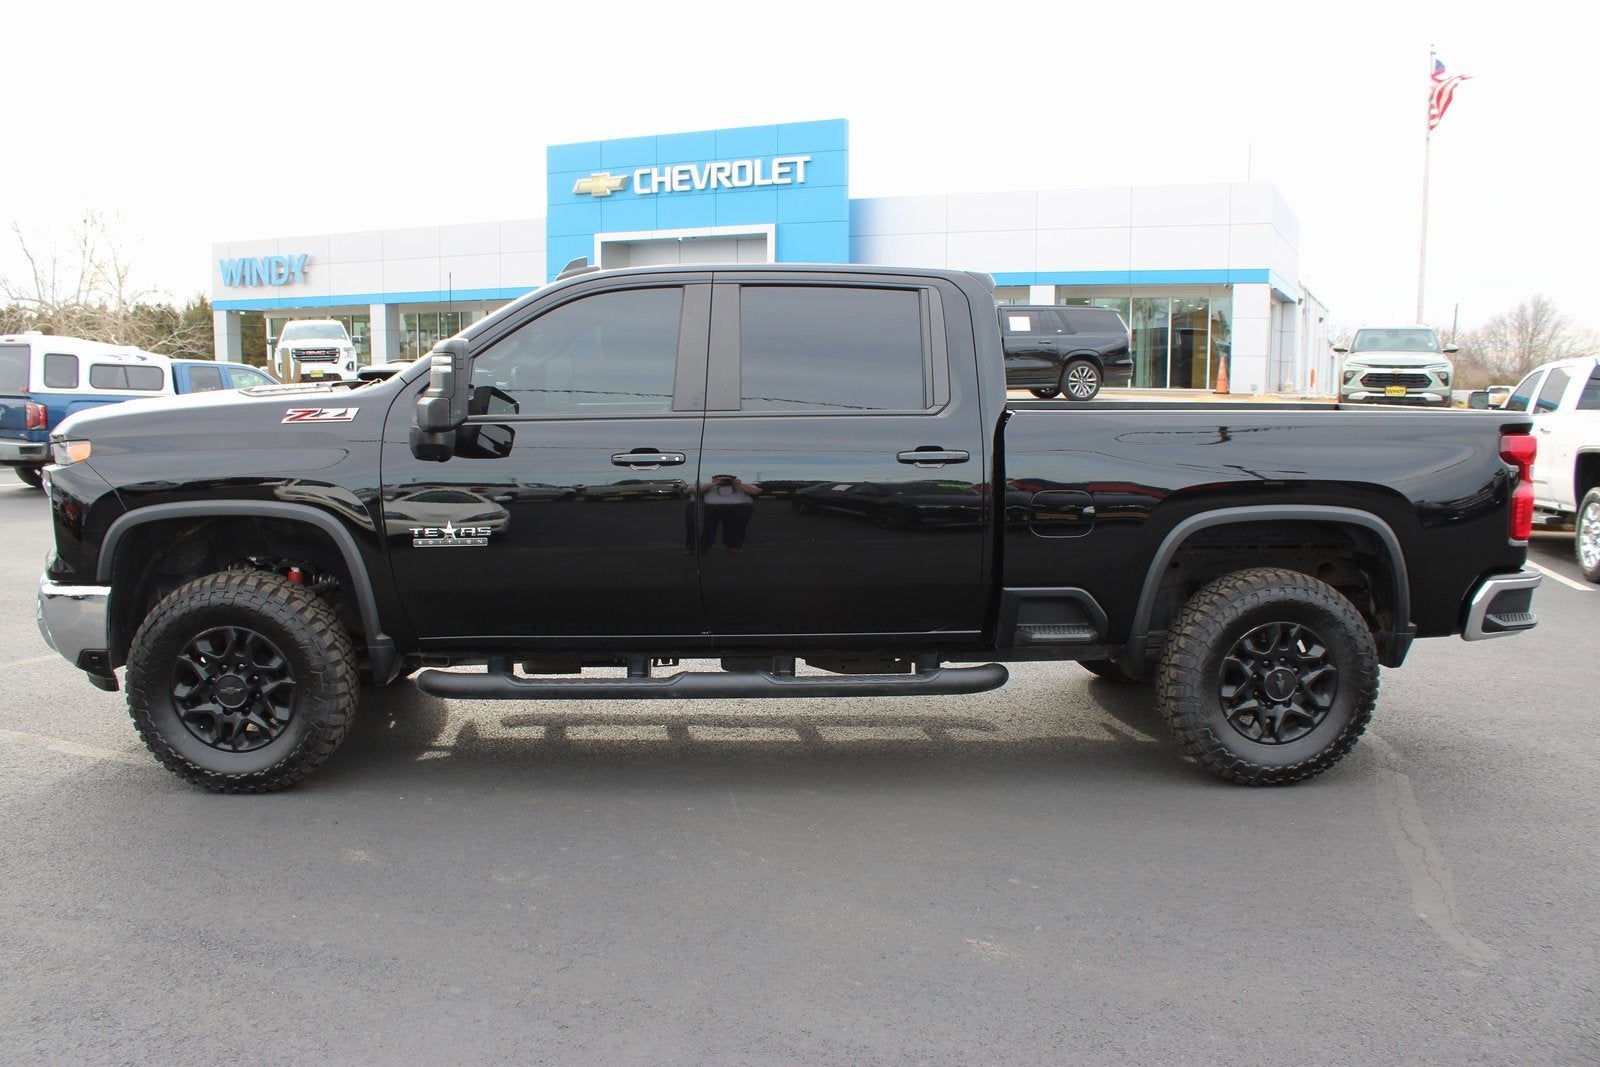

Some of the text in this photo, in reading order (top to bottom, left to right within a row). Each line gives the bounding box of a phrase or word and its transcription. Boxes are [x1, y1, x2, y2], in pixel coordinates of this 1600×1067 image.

[633, 155, 811, 195] CHEVROLET
[219, 253, 308, 288] WINDY
[281, 407, 360, 424] Z71
[409, 520, 492, 540] TEXAS
